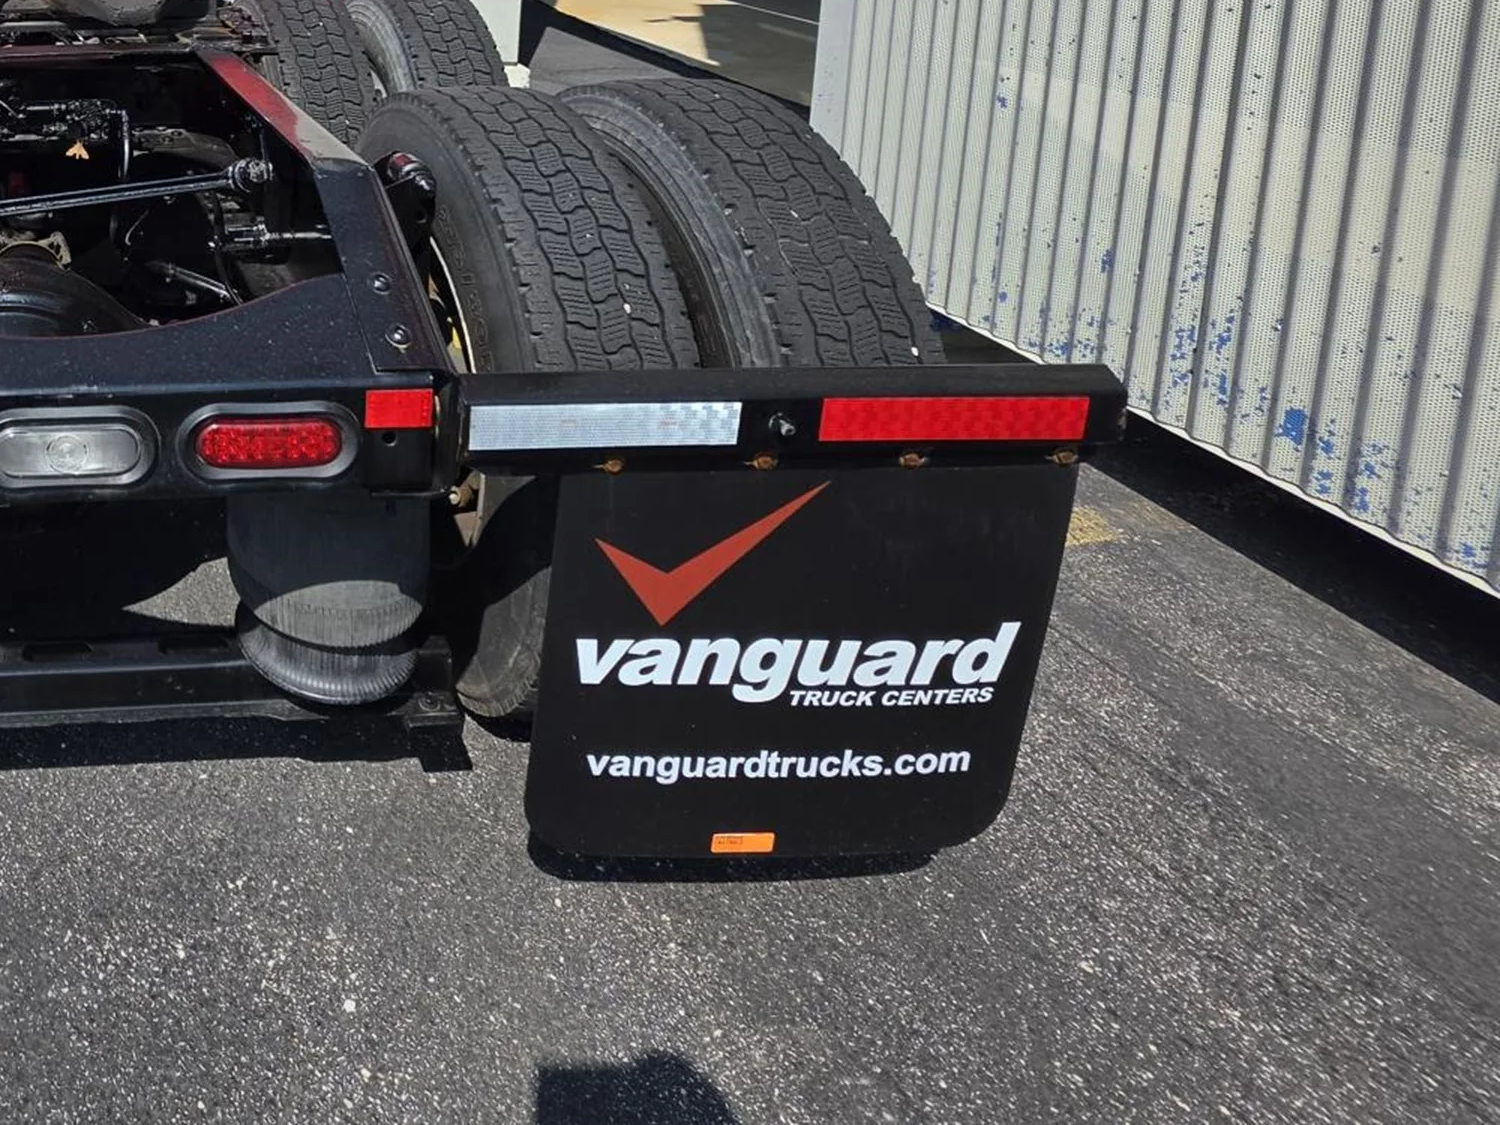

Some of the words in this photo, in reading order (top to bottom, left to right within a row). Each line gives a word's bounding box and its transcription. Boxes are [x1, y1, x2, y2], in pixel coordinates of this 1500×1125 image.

[576, 622, 1021, 702] vanguard
[790, 690, 876, 707] TRUCK
[882, 687, 994, 706] CENTERS
[587, 750, 971, 784] vanguardtrucks.com
